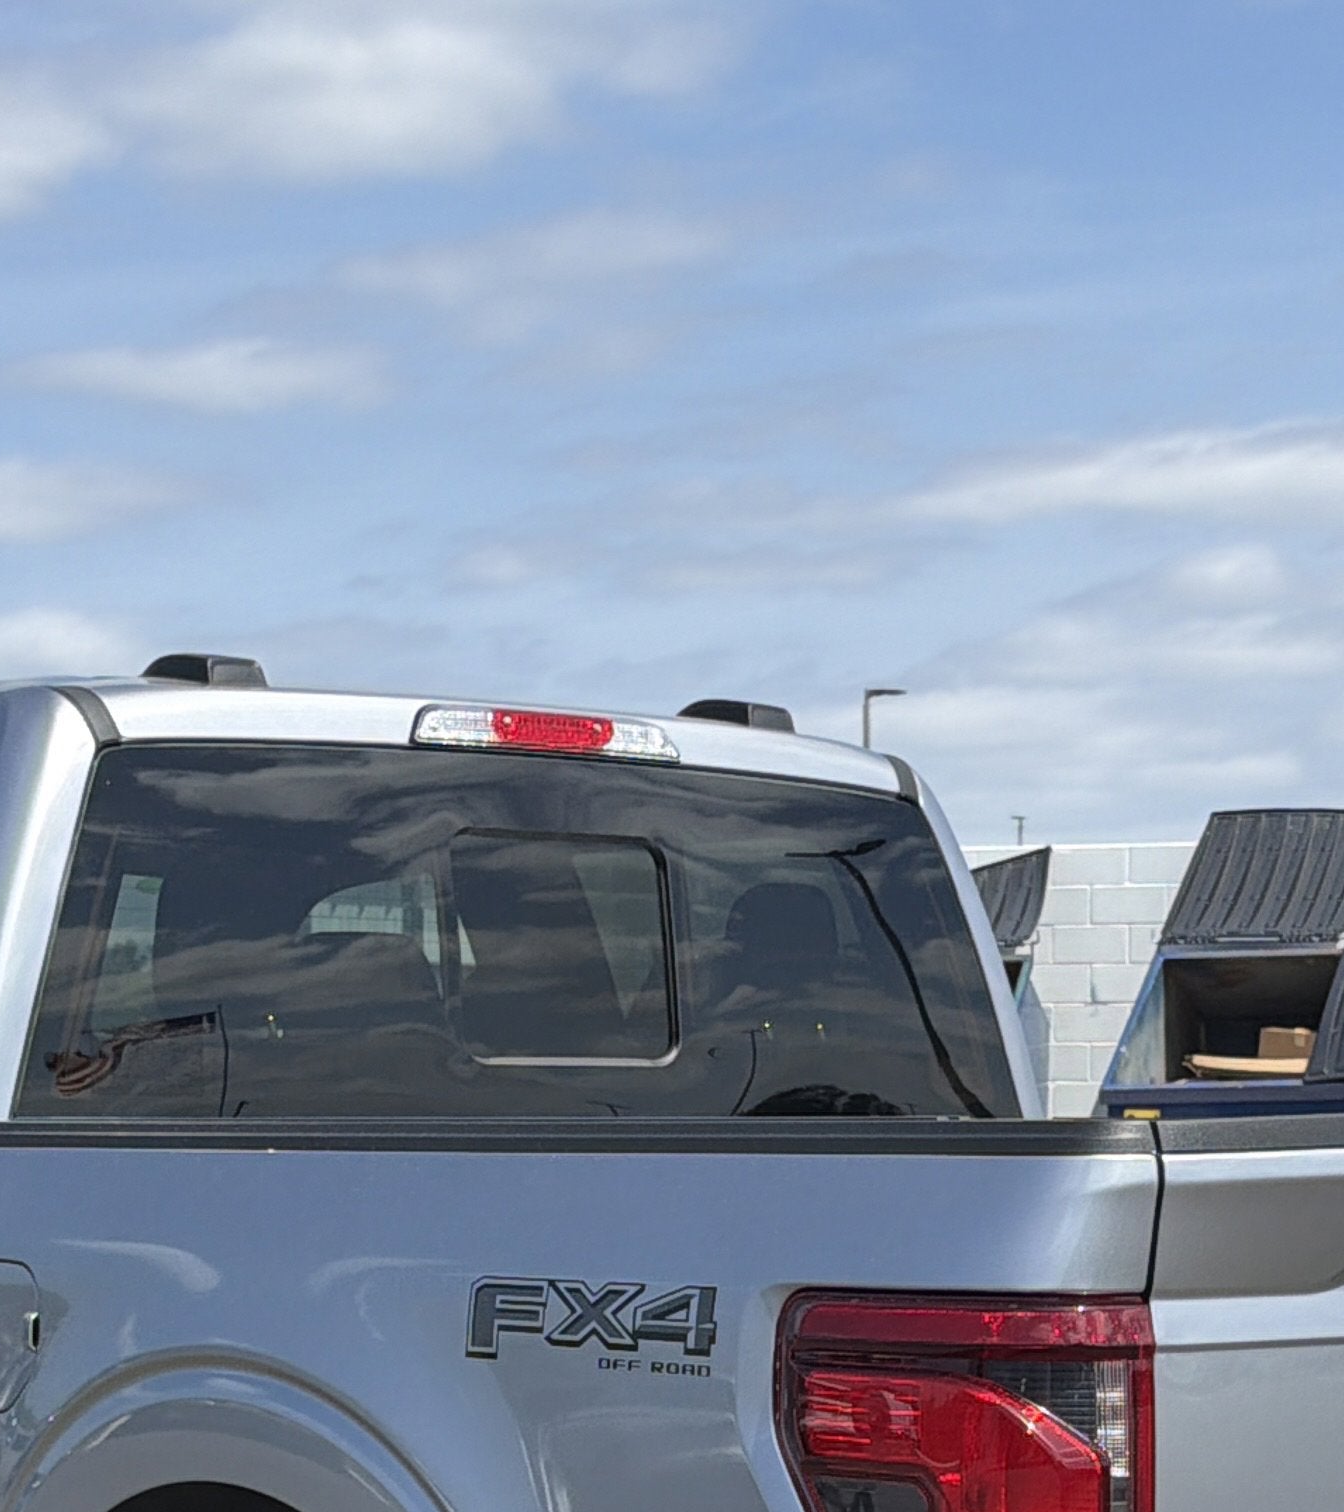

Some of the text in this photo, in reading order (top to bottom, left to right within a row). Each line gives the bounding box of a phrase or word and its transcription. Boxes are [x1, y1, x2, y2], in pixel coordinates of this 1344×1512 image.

[465, 1276, 717, 1359] FX4
[598, 1357, 711, 1377] OFF ROAD
